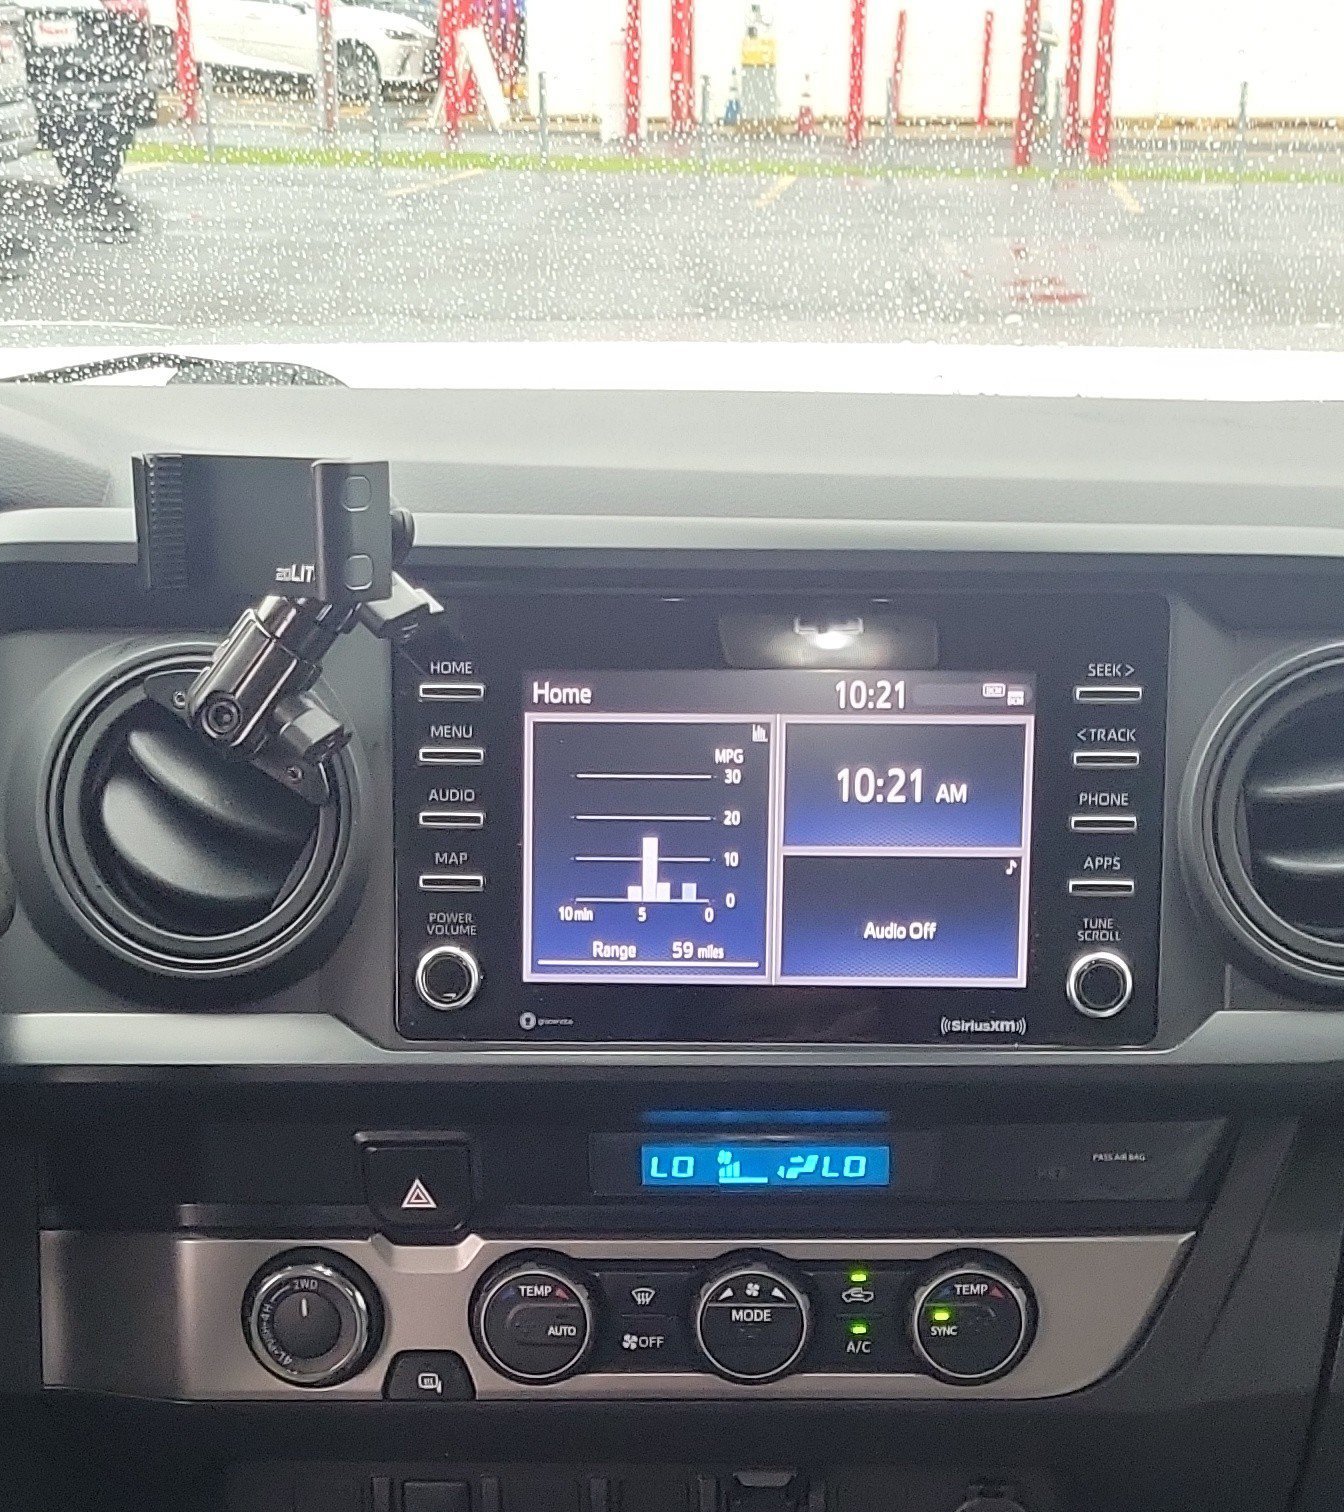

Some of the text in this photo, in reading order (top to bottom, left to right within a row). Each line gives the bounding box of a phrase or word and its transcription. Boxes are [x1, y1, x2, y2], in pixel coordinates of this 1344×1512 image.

[430, 661, 473, 674] HOME
[532, 681, 593, 705] Home
[835, 679, 906, 709] 10:21
[430, 725, 474, 739] MENU
[1088, 728, 1137, 742] TRACK
[714, 748, 744, 764] MPG
[724, 769, 742, 784] 30
[837, 767, 967, 804] 10:21 AM
[429, 788, 476, 801] AUDIO
[1079, 792, 1130, 806] PHONE
[724, 810, 741, 826] 20
[434, 852, 468, 865] MAP
[724, 852, 739, 867] 10
[1083, 856, 1121, 870] APPS
[725, 893, 736, 908] 0
[429, 912, 473, 924] POWER
[638, 907, 647, 922] 5
[704, 908, 714, 923] 0
[426, 924, 477, 936] VOLUME
[863, 921, 937, 940] Audio Off
[1082, 917, 1114, 930] TUNE
[1077, 930, 1121, 942] SCROLL
[592, 941, 725, 960] Range 59 miles
[650, 1155, 695, 1178] LO
[821, 1155, 867, 1178] LO
[293, 1279, 319, 1291] 2WD
[518, 1285, 553, 1298] TEMP
[955, 1284, 989, 1297] TEMP
[731, 1309, 772, 1322] MODE
[547, 1324, 577, 1337] AUTO
[930, 1325, 958, 1337] SYNC
[638, 1336, 665, 1349] OFF
[846, 1341, 871, 1355] A/C
